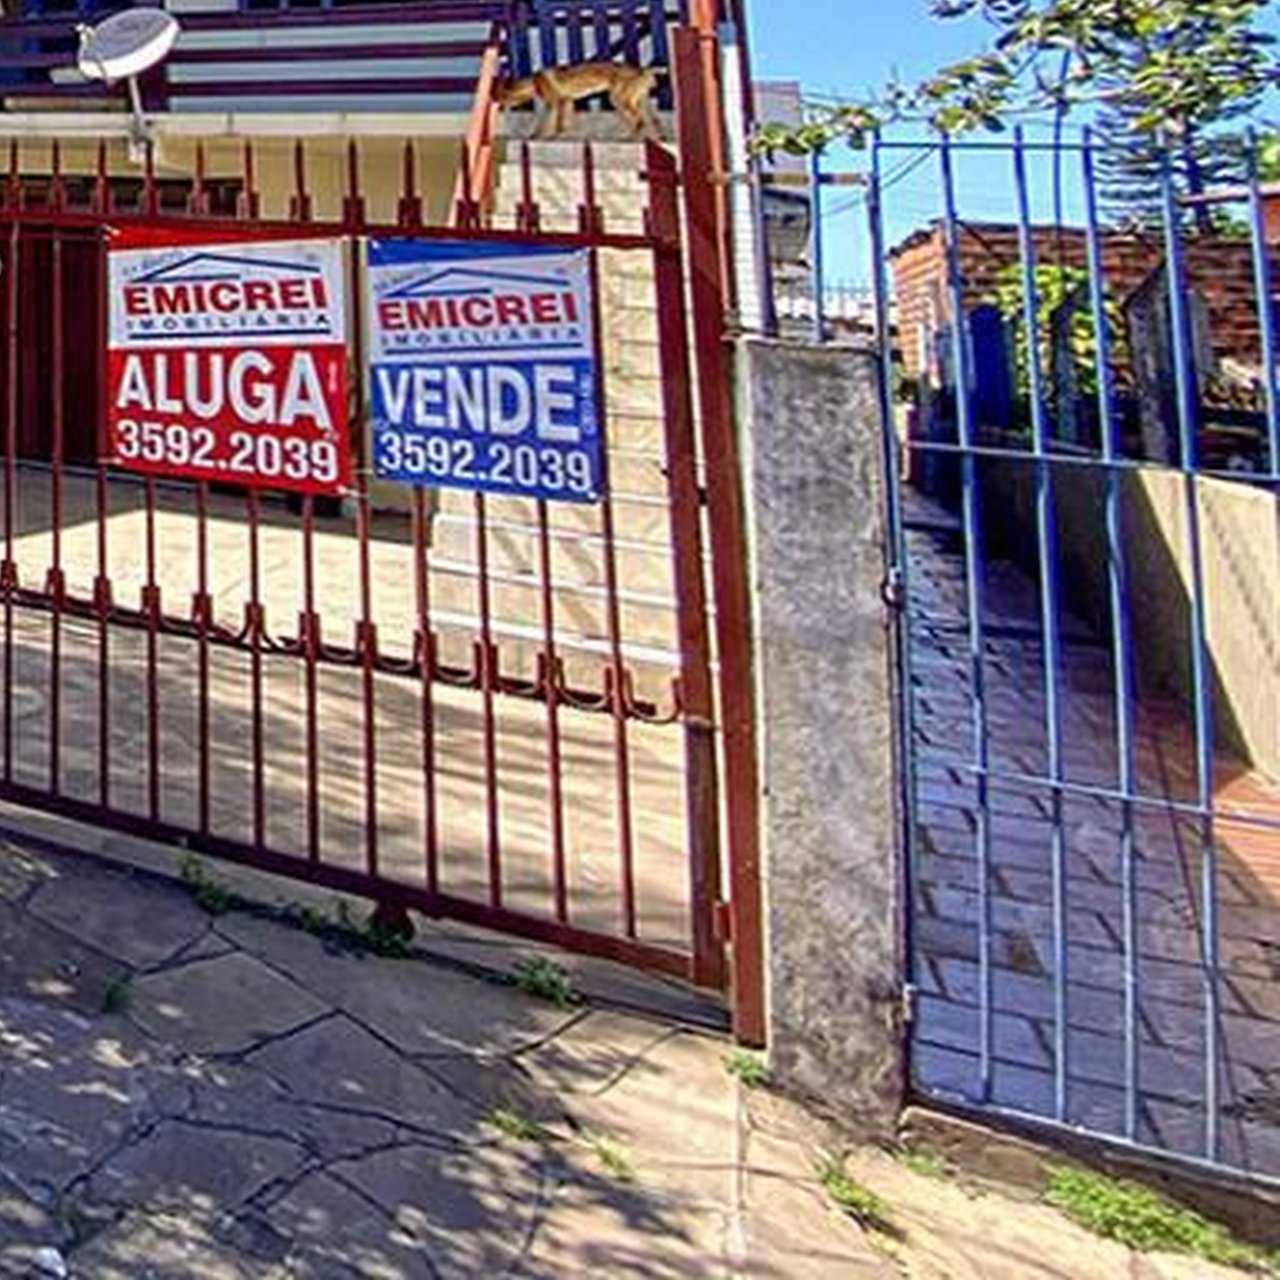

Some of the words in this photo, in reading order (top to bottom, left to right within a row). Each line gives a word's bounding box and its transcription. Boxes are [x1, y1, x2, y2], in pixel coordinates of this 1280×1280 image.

[122, 277, 329, 316] EMICREI
[376, 291, 580, 331] EMICREI
[115, 349, 335, 431] ALUGA
[376, 363, 582, 444] VENDE
[116, 419, 340, 483] 3592.2039
[378, 431, 593, 493] 3592.2039
